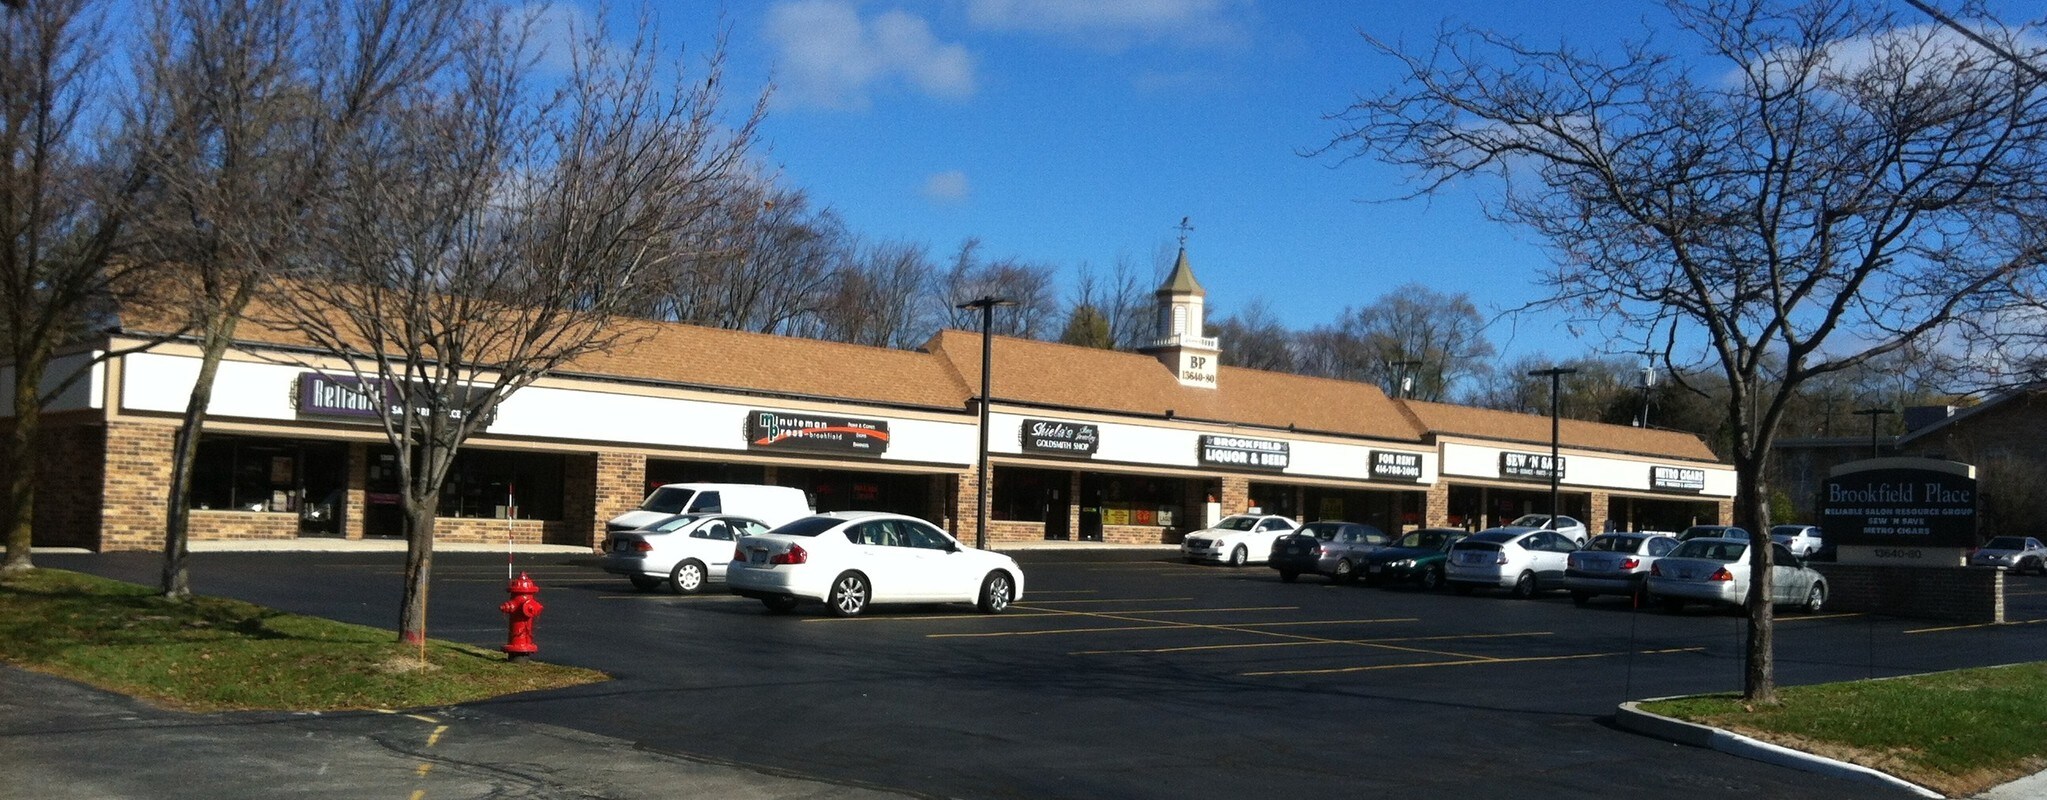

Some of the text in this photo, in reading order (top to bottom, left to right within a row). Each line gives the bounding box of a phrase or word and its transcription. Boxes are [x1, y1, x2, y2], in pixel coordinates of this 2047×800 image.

[1190, 356, 1206, 369] BP
[1182, 370, 1215, 384] 13640-80
[1036, 439, 1090, 451] GOLDSMITH SHOP
[1213, 437, 1282, 451] BROOKFIELD
[1205, 449, 1287, 467] LIQUOR & BEER
[1378, 453, 1416, 466] FOR RENT
[1506, 453, 1527, 467] SEW
[1540, 457, 1564, 471] SAE
[1655, 467, 1704, 481] METRO CIGARS
[1829, 483, 1970, 503] Brookfield Place
[1896, 527, 1930, 535] CIGARS
